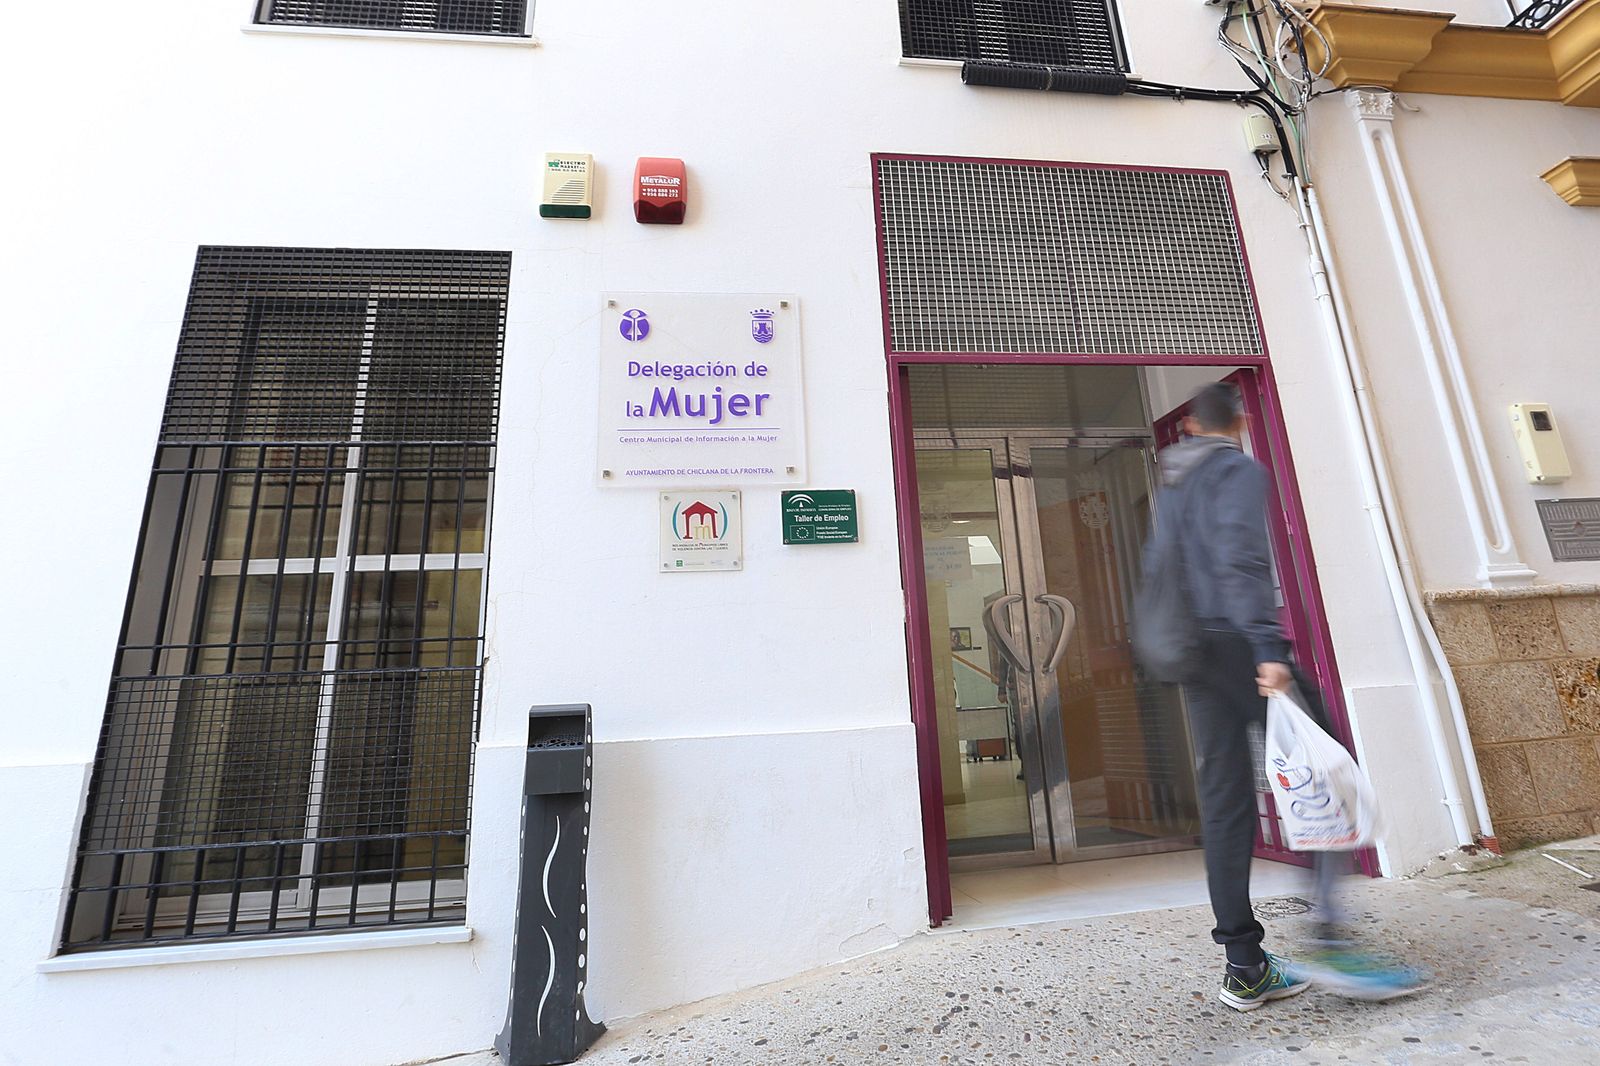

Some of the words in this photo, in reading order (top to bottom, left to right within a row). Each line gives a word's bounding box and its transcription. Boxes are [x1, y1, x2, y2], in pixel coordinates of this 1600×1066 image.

[628, 361, 737, 380] Delegación
[744, 361, 768, 377] de
[626, 401, 644, 417] la
[649, 386, 770, 424] Mujer
